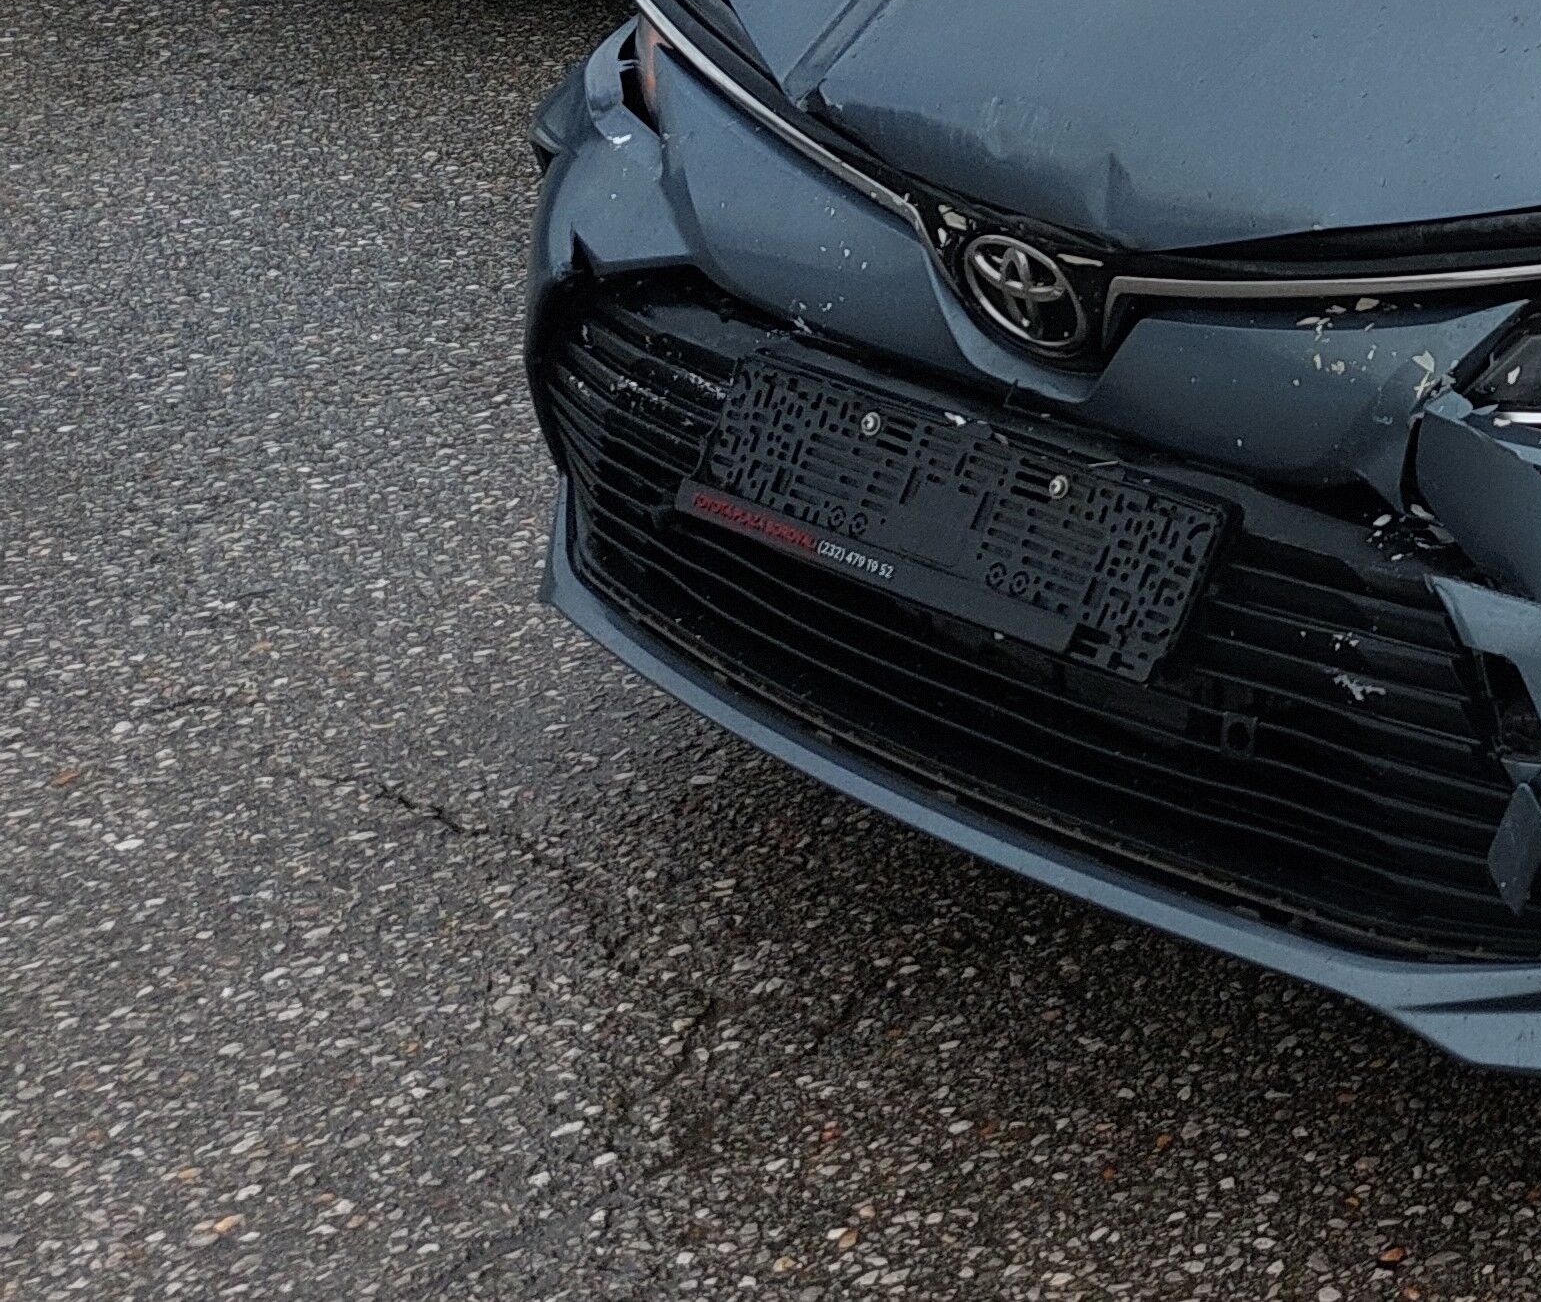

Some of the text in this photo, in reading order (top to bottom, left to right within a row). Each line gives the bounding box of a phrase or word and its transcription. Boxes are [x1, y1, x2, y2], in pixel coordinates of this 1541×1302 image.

[817, 539, 846, 562] (232)
[845, 550, 866, 568] 479
[879, 563, 895, 579] 52
